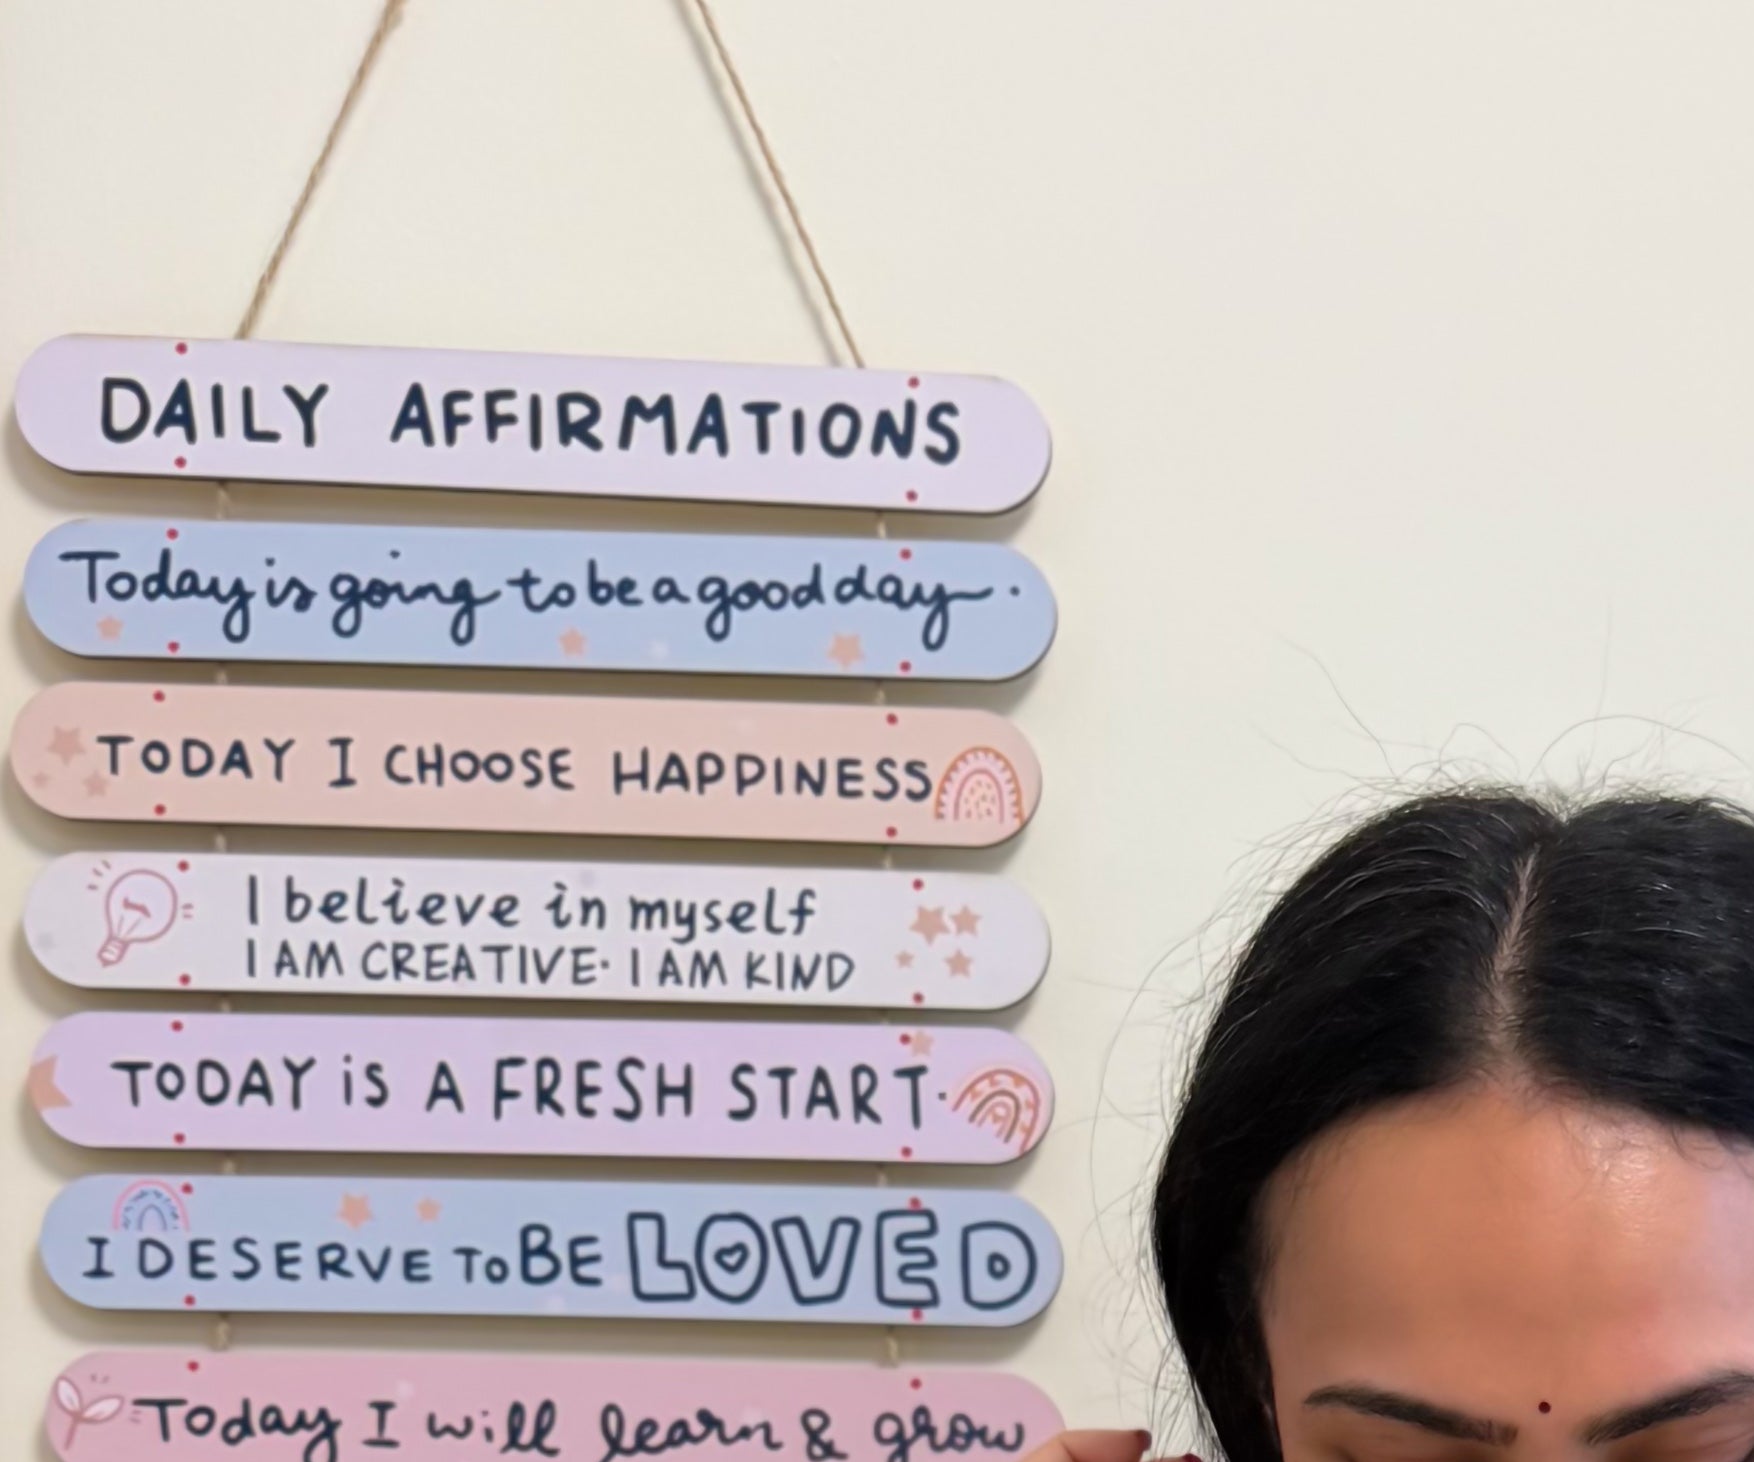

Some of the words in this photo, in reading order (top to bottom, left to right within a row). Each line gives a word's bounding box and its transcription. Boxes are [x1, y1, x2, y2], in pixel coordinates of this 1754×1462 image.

[100, 377, 329, 448] DAILY
[390, 384, 960, 464] AFFIRMATIONS
[58, 547, 255, 644] Today
[265, 557, 318, 613] is
[329, 550, 501, 647] going
[506, 568, 577, 614] to
[587, 558, 644, 607] be
[651, 576, 691, 604] a
[696, 563, 826, 643] good
[96, 735, 295, 782] TODAY
[328, 736, 357, 789] I
[384, 743, 575, 791] CHOOSE
[613, 746, 933, 803] HAPPINESS
[248, 874, 259, 926] I
[285, 875, 519, 928] believe
[544, 881, 607, 930] in
[628, 887, 816, 946] myself
[246, 938, 256, 978] I
[274, 939, 344, 979] AM
[630, 947, 640, 987] I
[658, 948, 727, 989] AM
[744, 951, 855, 992] KIND
[110, 1057, 316, 1111] TODAY
[425, 1061, 464, 1113] A
[493, 1056, 693, 1123] FRESH
[82, 1236, 114, 1280] I
[137, 1236, 432, 1284] DESERVE
[519, 1223, 603, 1287] BE
[626, 1210, 1038, 1308] LOVED
[362, 1400, 400, 1449] I
[426, 1399, 560, 1458] will
